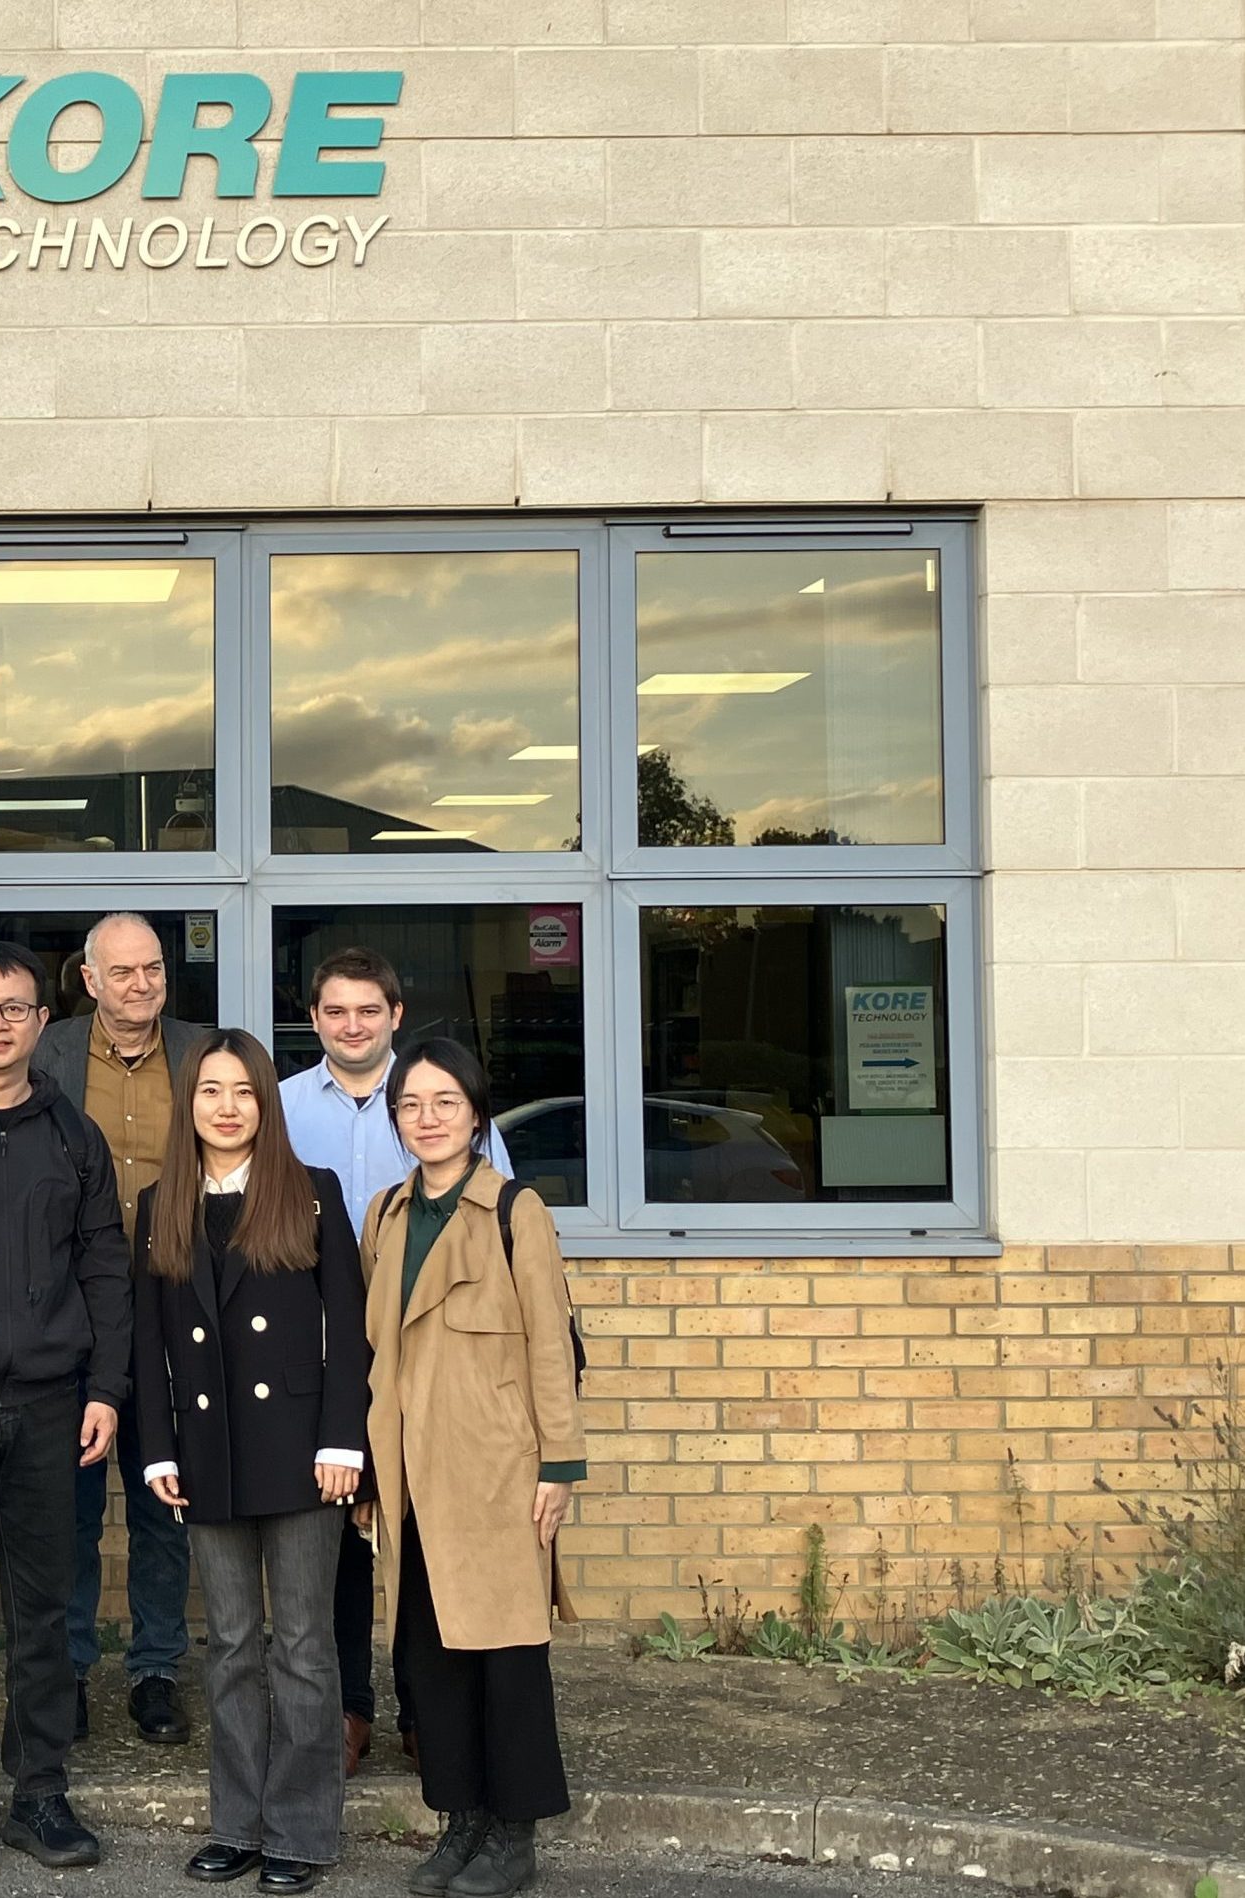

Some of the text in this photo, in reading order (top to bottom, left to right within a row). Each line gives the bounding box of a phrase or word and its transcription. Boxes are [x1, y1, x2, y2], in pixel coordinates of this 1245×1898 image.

[534, 938, 562, 947] Alarm
[852, 992, 927, 1011] KORE
[852, 1012, 928, 1022] TECHNOLOGY
